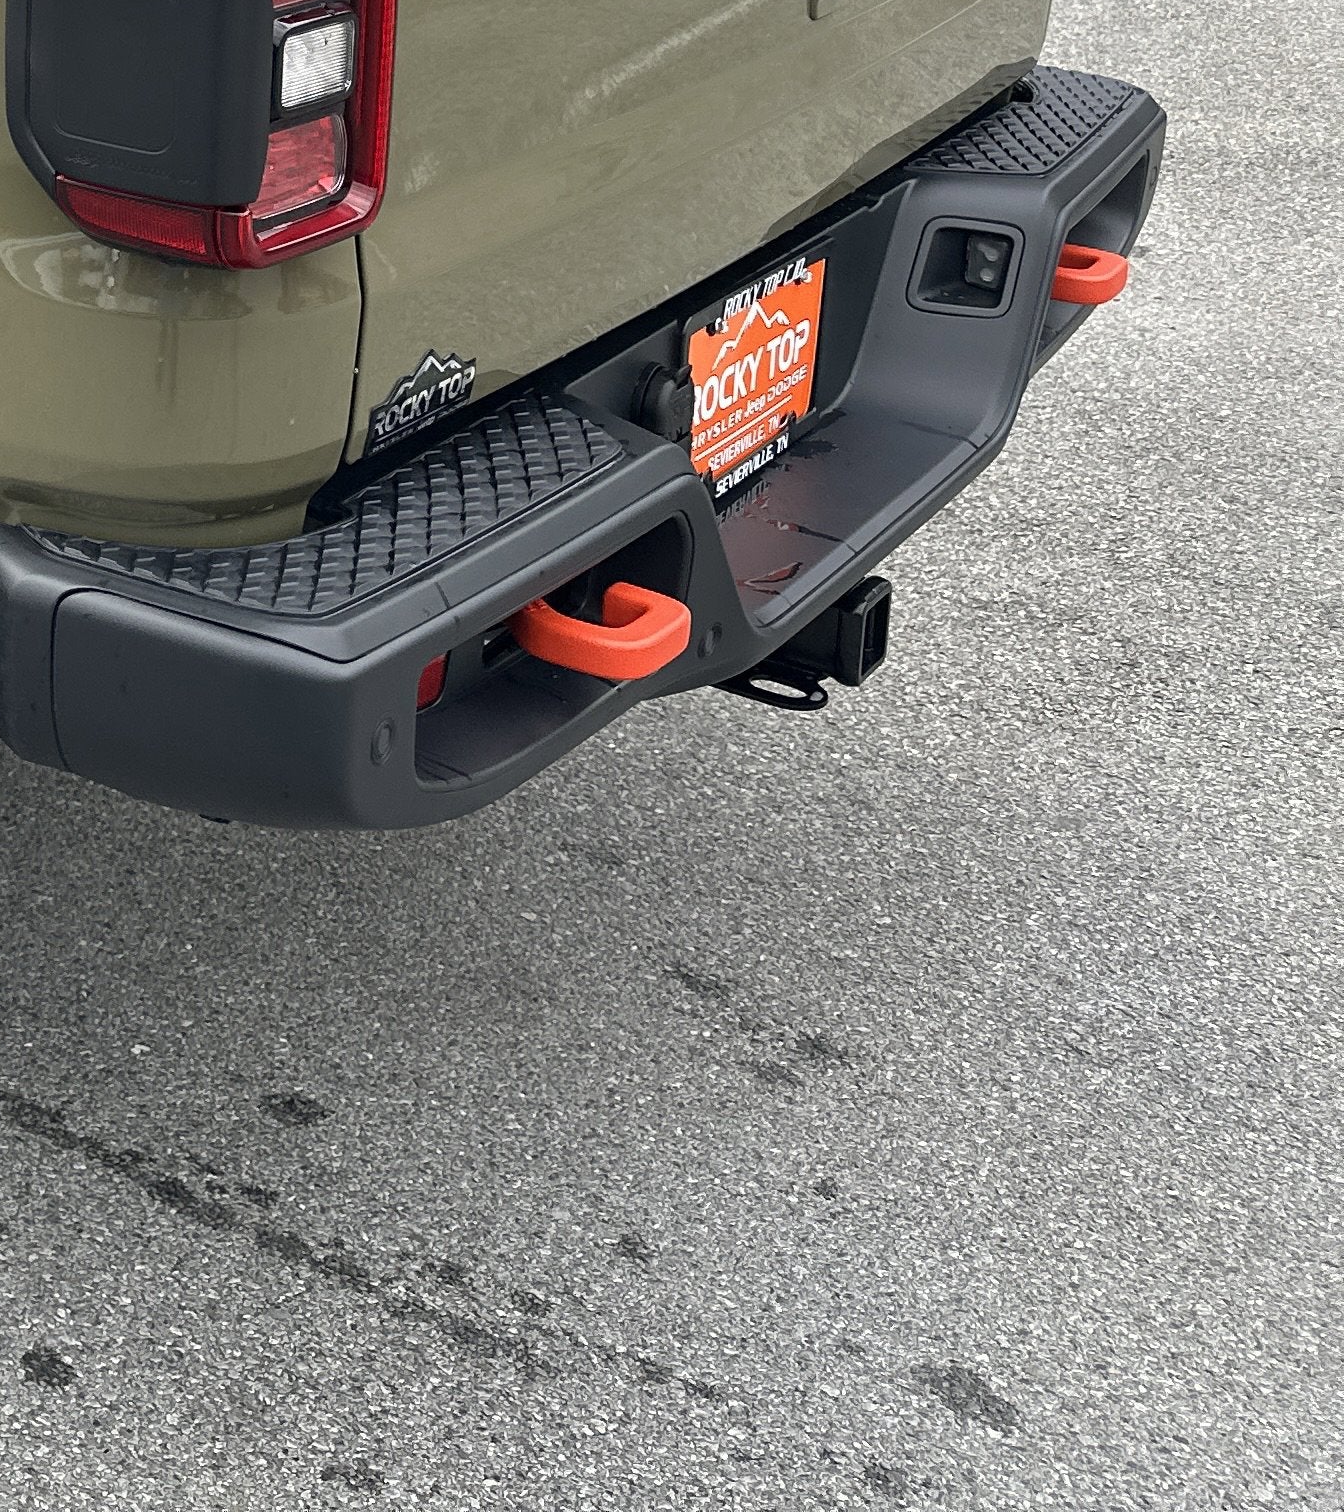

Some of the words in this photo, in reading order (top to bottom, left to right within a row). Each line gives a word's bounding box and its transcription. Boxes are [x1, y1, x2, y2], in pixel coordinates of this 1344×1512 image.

[723, 282, 762, 320] ROCKY
[762, 269, 785, 298] TOP
[766, 319, 811, 380] TOP
[374, 384, 437, 436] ROCKY
[438, 366, 476, 405] TOP
[744, 394, 766, 419] Jeep
[768, 362, 808, 403] DODGE
[776, 432, 790, 454] TN
